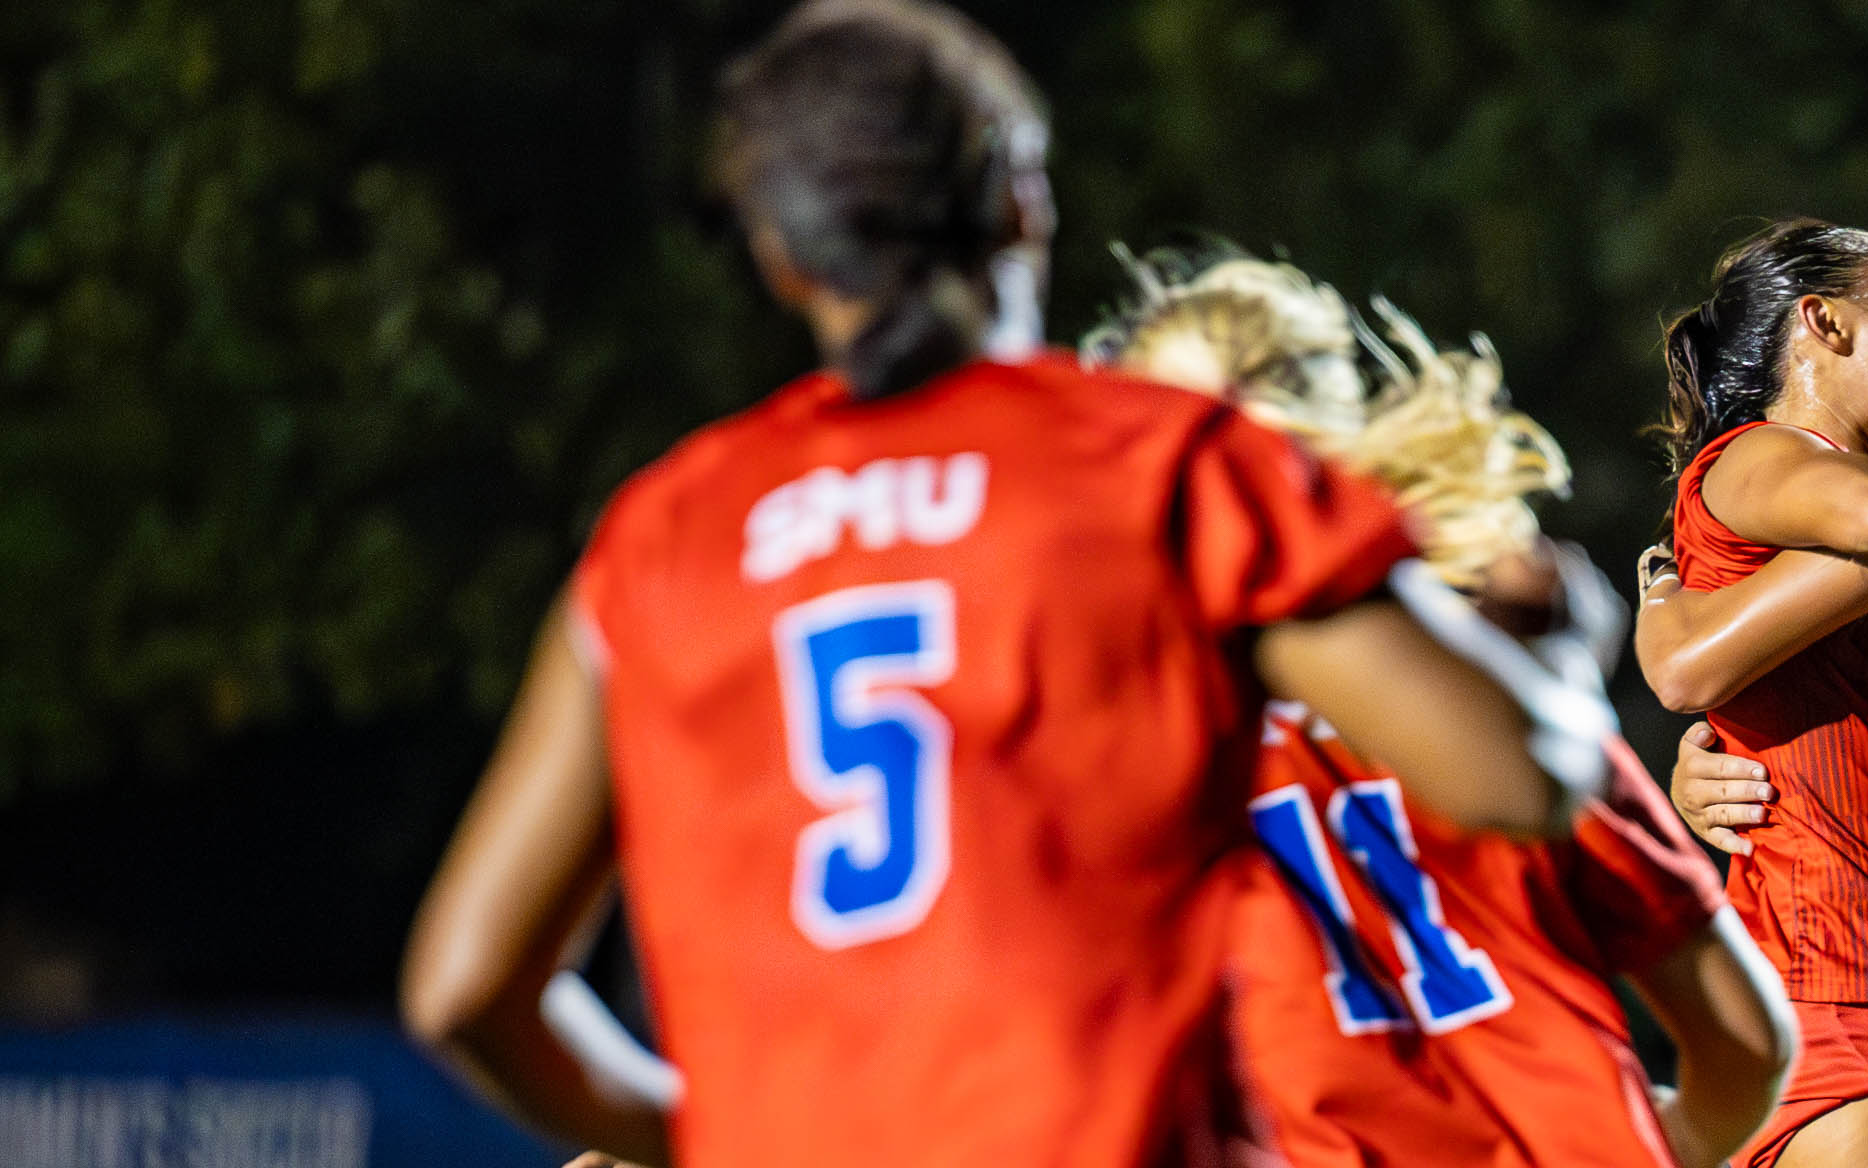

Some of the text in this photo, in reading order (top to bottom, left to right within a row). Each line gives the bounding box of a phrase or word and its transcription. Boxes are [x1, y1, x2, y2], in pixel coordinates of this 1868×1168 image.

[743, 450, 991, 583] SMU
[774, 580, 956, 952] 5
[1249, 777, 1515, 1036] 11
